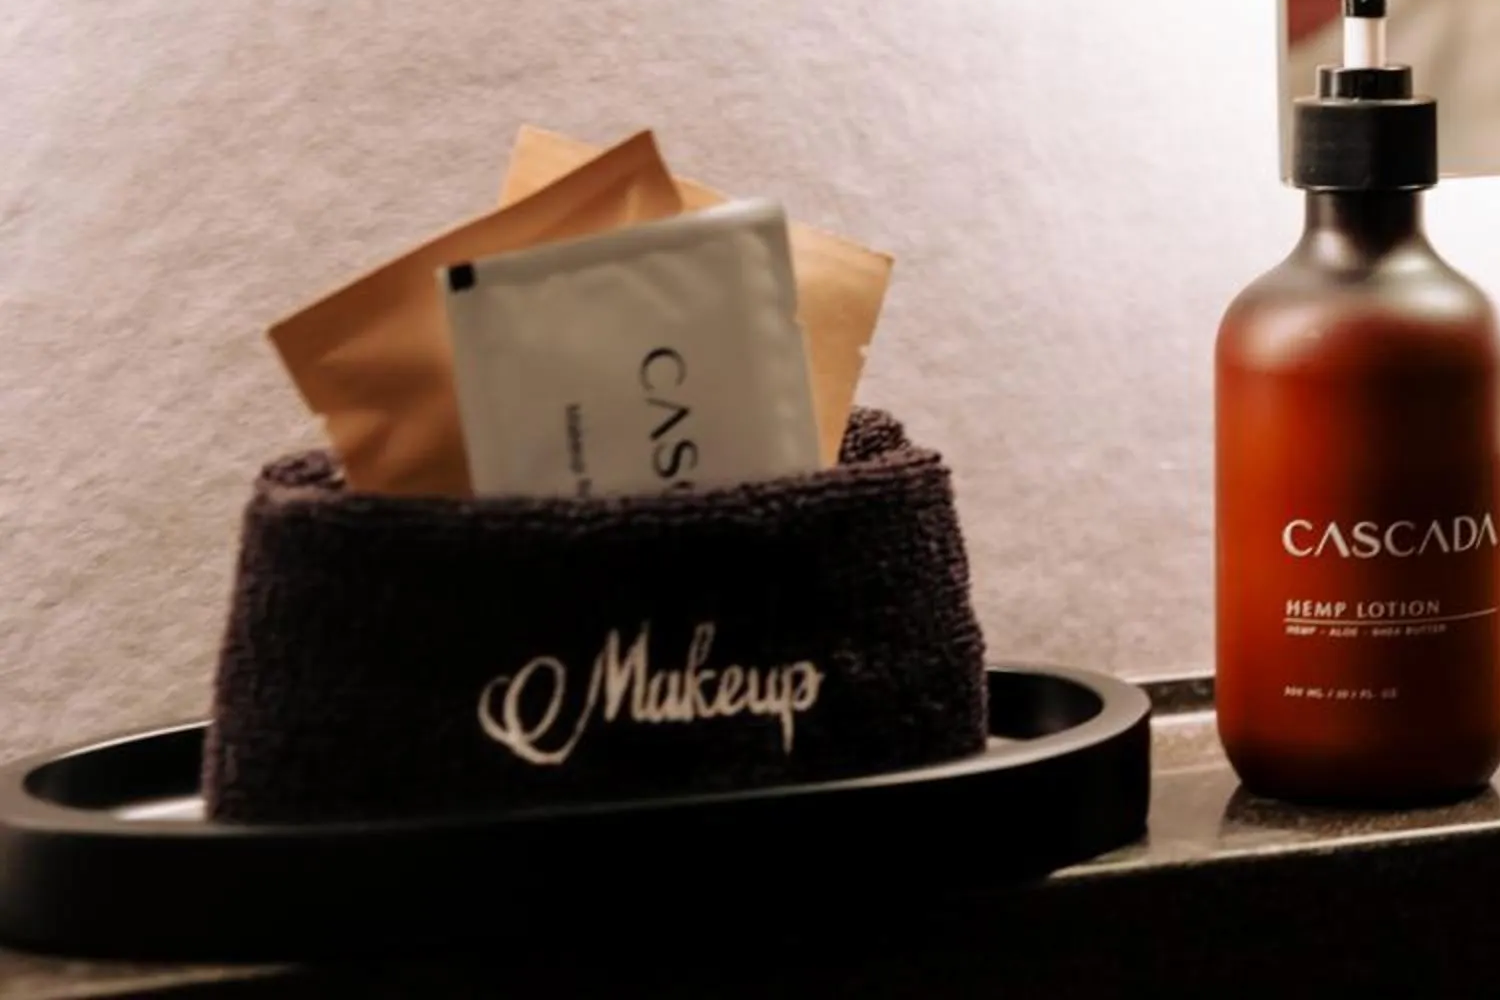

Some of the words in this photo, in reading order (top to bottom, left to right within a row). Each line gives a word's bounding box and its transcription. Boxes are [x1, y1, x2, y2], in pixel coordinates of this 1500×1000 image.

[1281, 511, 1498, 559] CASCADA
[1285, 598, 1348, 619] HEMP
[1356, 599, 1441, 620] LOTION
[477, 620, 826, 765] Makeup
